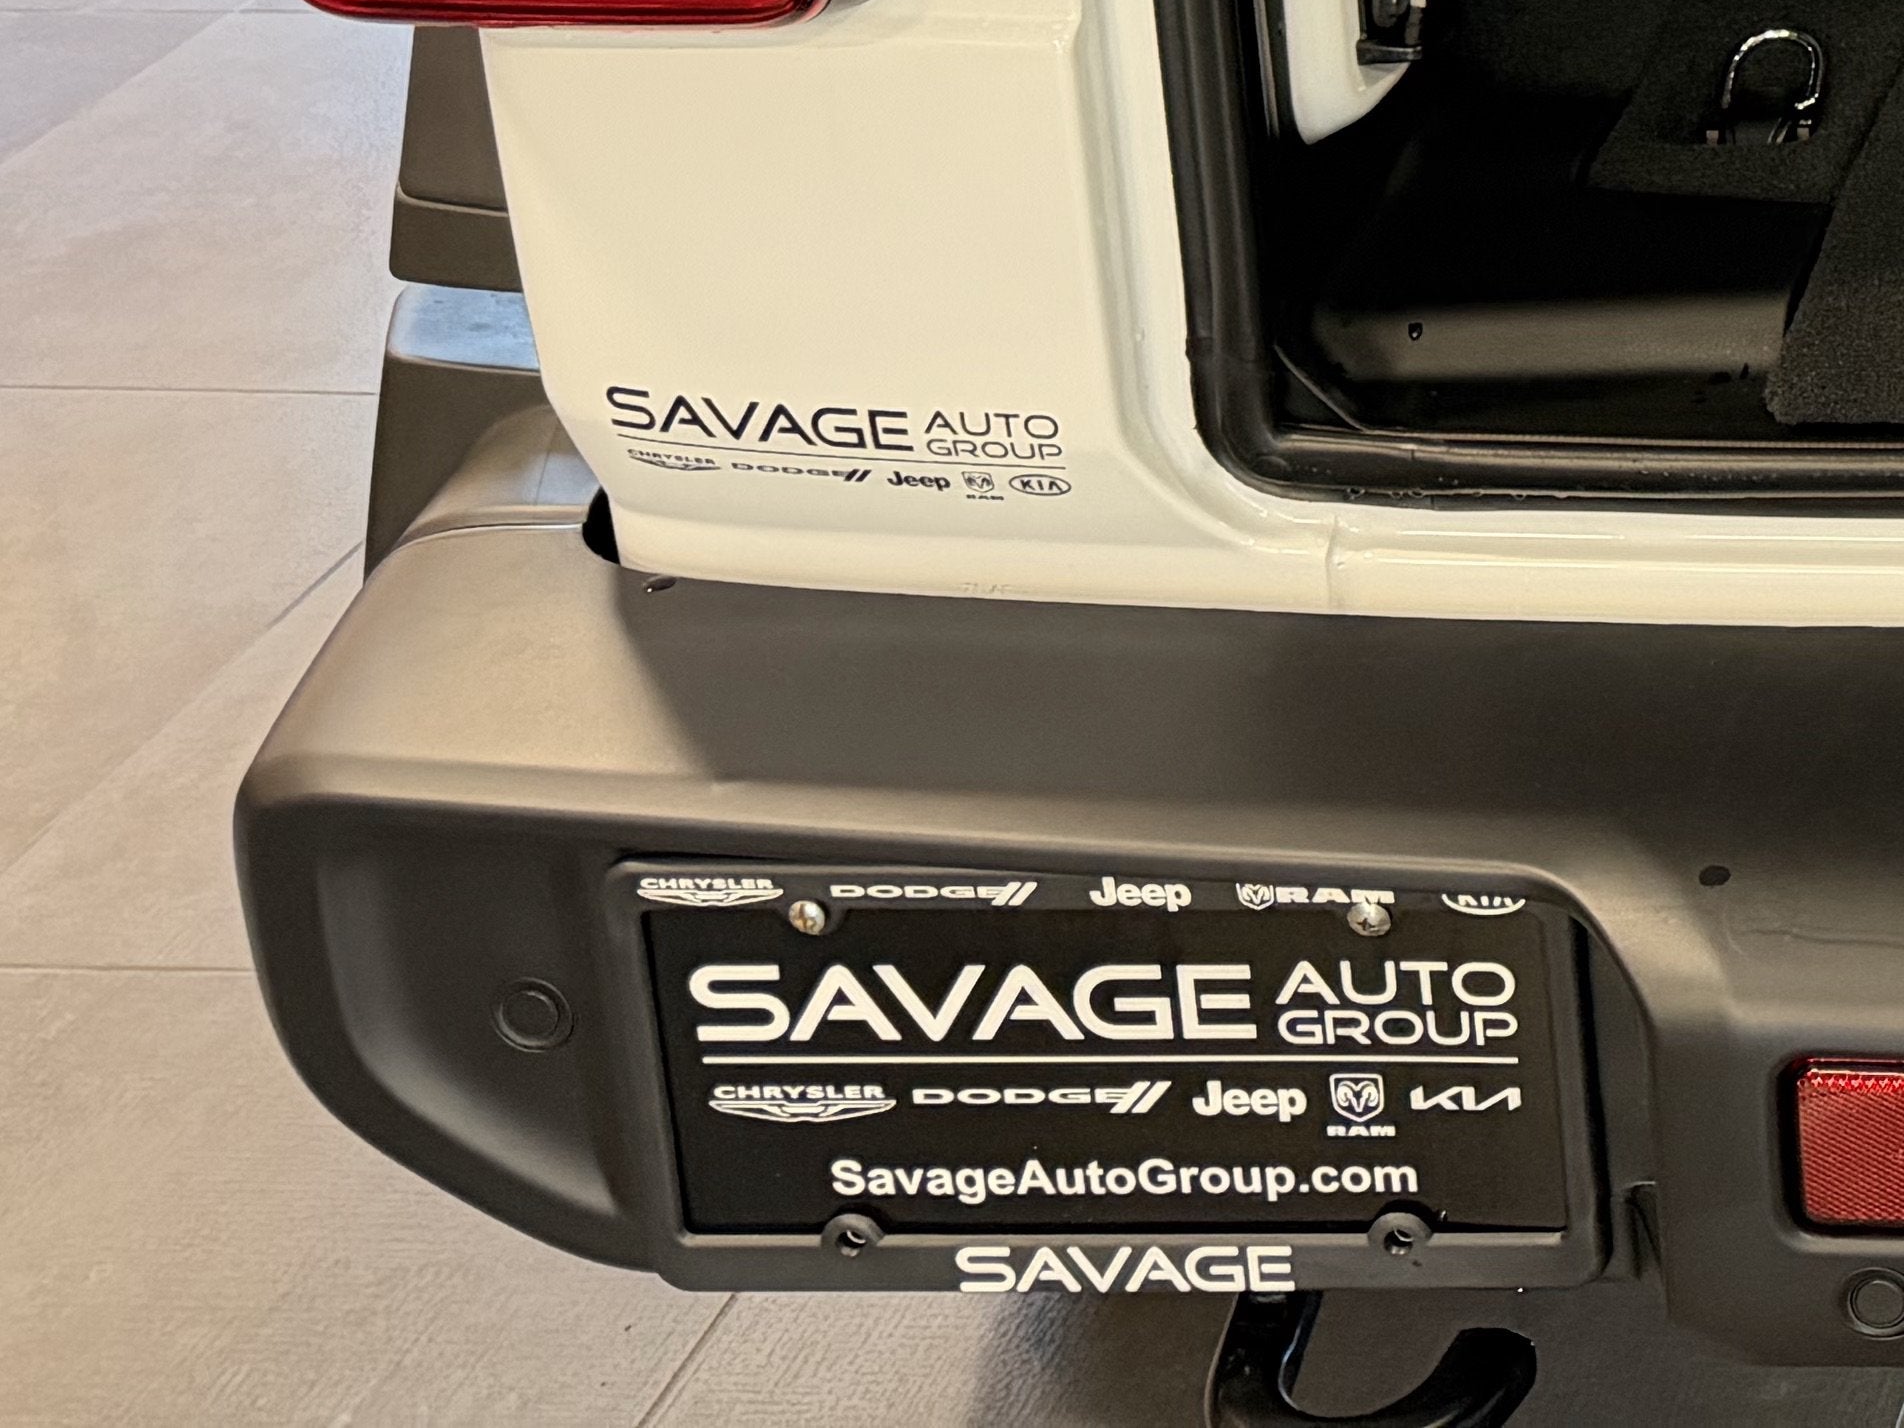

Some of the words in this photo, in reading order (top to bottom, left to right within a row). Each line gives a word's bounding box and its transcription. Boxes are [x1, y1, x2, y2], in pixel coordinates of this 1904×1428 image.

[605, 386, 914, 452] SAVAGE
[924, 410, 1060, 440] AUTO
[627, 448, 716, 465] CHRYSLER
[731, 462, 851, 479] DODGE
[887, 470, 951, 492] Jeep
[926, 438, 1063, 461] GROUP
[639, 877, 775, 891] CHRYSLER
[830, 884, 1003, 900] DODGE
[1089, 876, 1192, 912] Jeep
[1275, 886, 1395, 904] RAM
[688, 964, 1258, 1042] SAVAGE
[1275, 960, 1516, 1007] AUTO
[1277, 1009, 1519, 1046] GROUP
[713, 1083, 885, 1099] CHRYSLER
[912, 1087, 1133, 1105] DODGE
[1192, 1080, 1308, 1122] Jeep
[1326, 1125, 1396, 1137] RAM
[830, 1158, 1418, 1205] SavageAutoGroup.com
[954, 1245, 1296, 1293] SAVAGE
